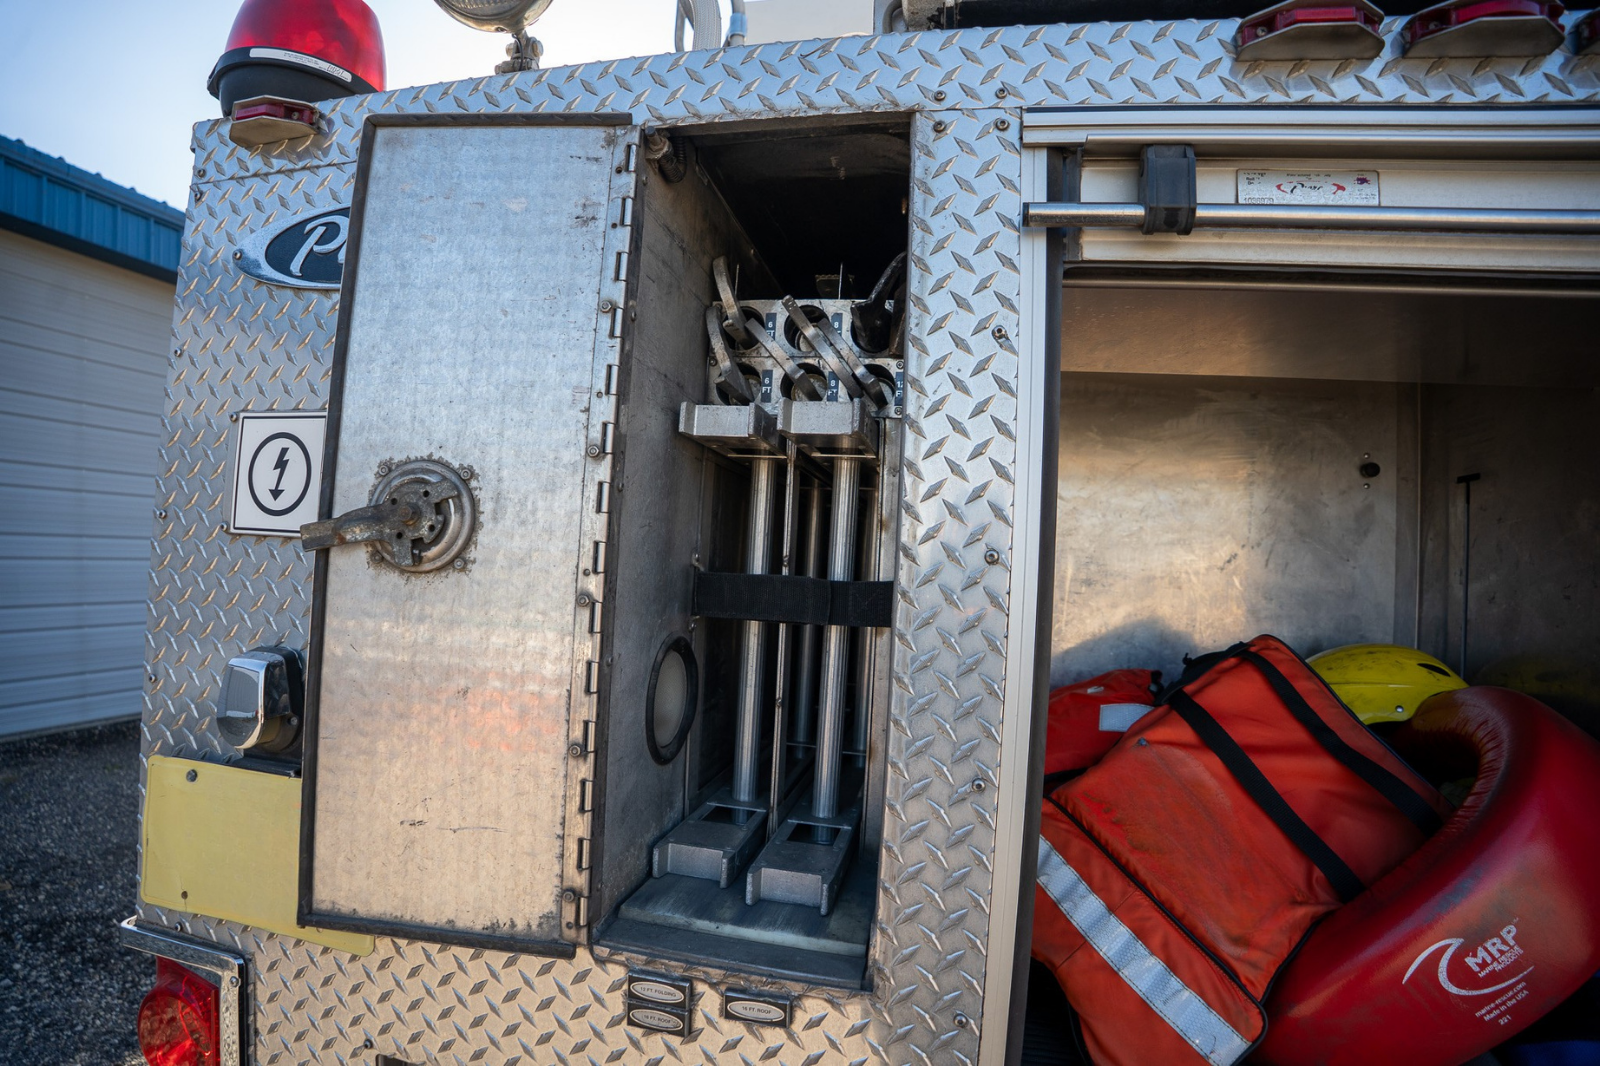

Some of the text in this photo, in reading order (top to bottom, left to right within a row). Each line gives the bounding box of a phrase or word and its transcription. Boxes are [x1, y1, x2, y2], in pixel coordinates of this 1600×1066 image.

[834, 321, 839, 329] 8
[764, 377, 770, 385] 6
[830, 379, 836, 387] 8
[761, 386, 771, 394] FT
[1464, 924, 1517, 972] MRP
[1475, 981, 1527, 1017] marine-rescue.com
[1484, 1008, 1501, 1021] Made
[1506, 998, 1517, 1008] the
[1515, 989, 1529, 1001] USA
[757, 1007, 771, 1015] ROOF
